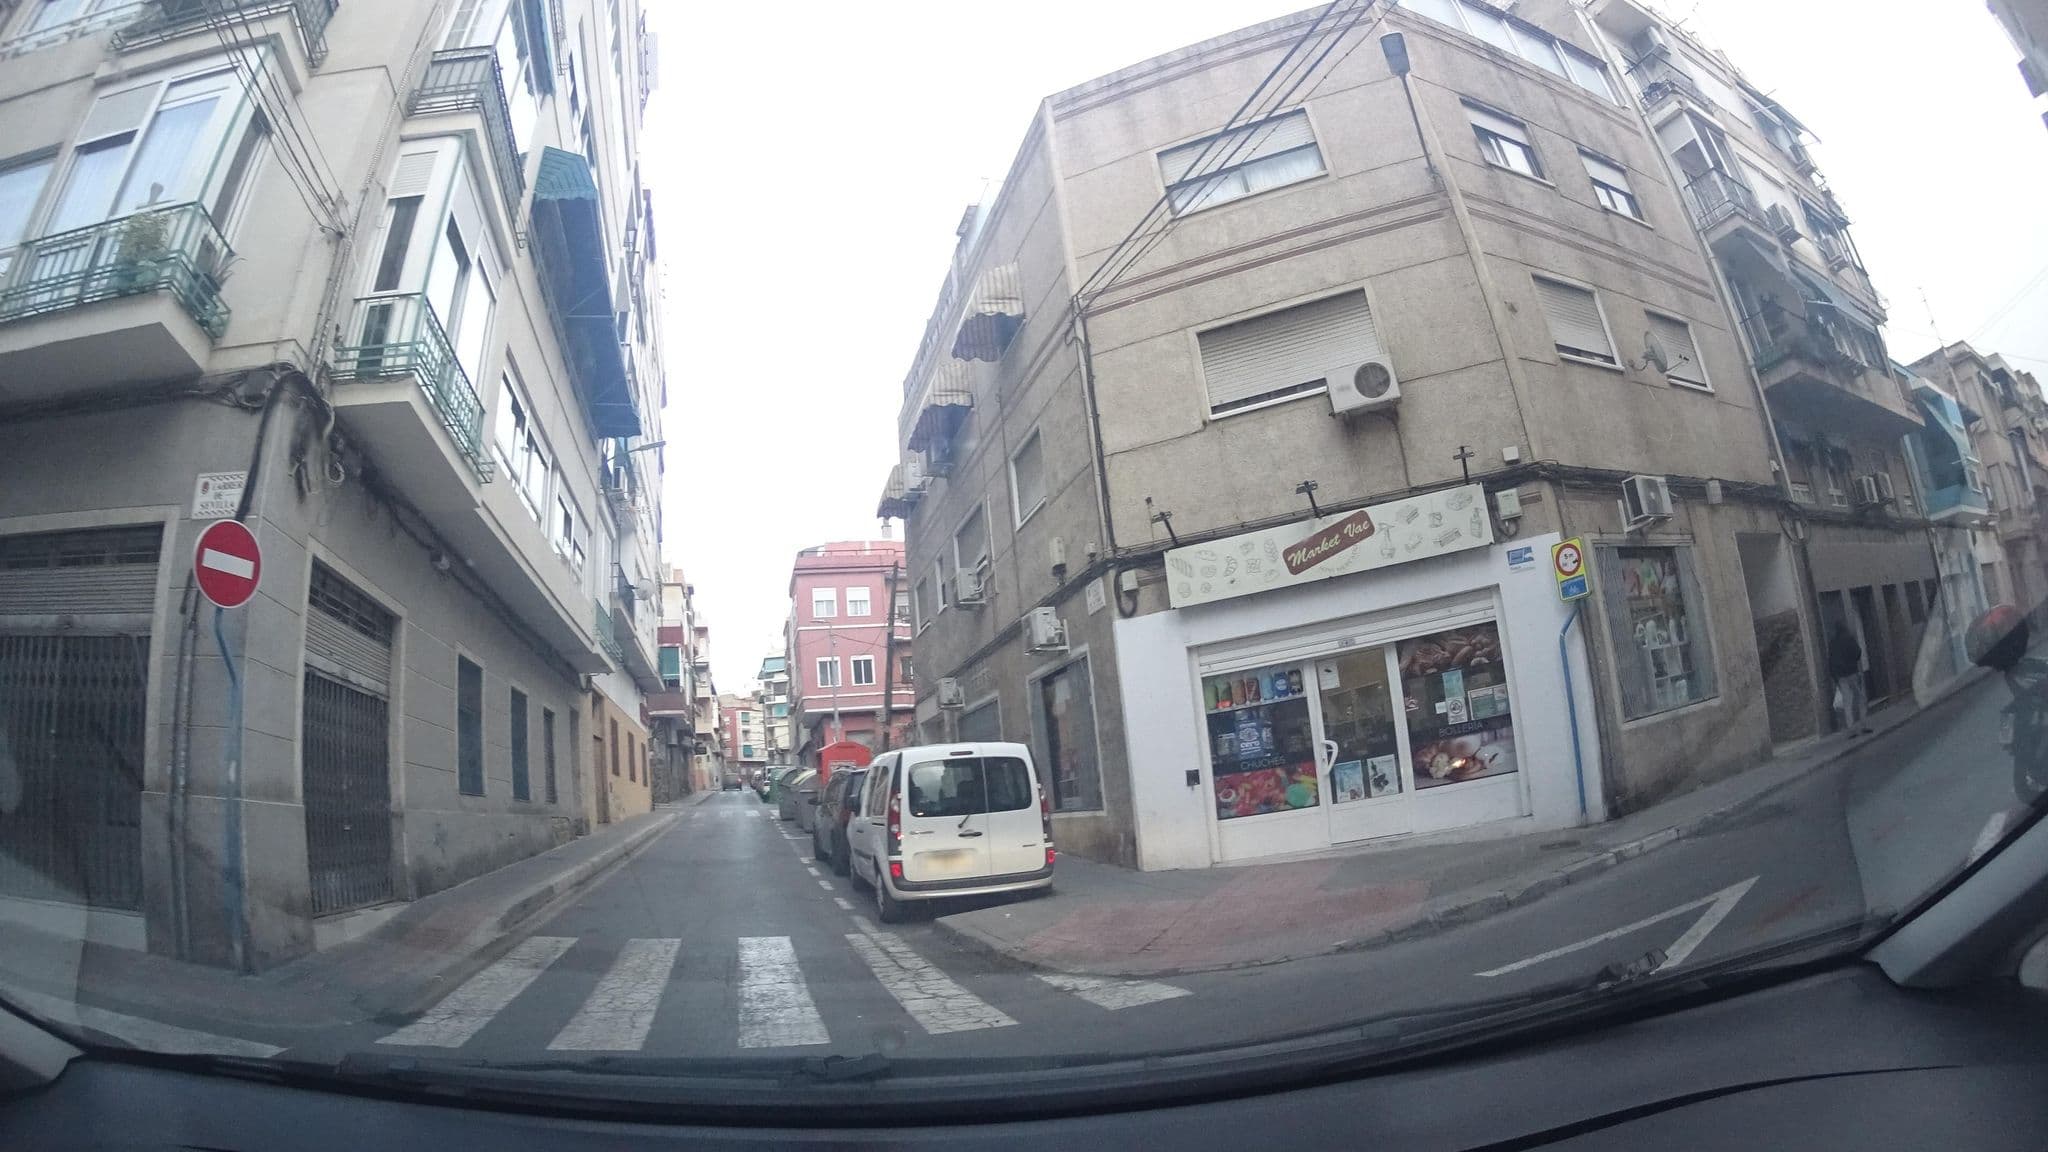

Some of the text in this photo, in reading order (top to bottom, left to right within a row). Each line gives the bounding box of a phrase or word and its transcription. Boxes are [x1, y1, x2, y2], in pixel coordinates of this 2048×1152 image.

[200, 502, 234, 510] SEVILLA
[1287, 534, 1341, 567] Market
[1344, 520, 1370, 537] Vac
